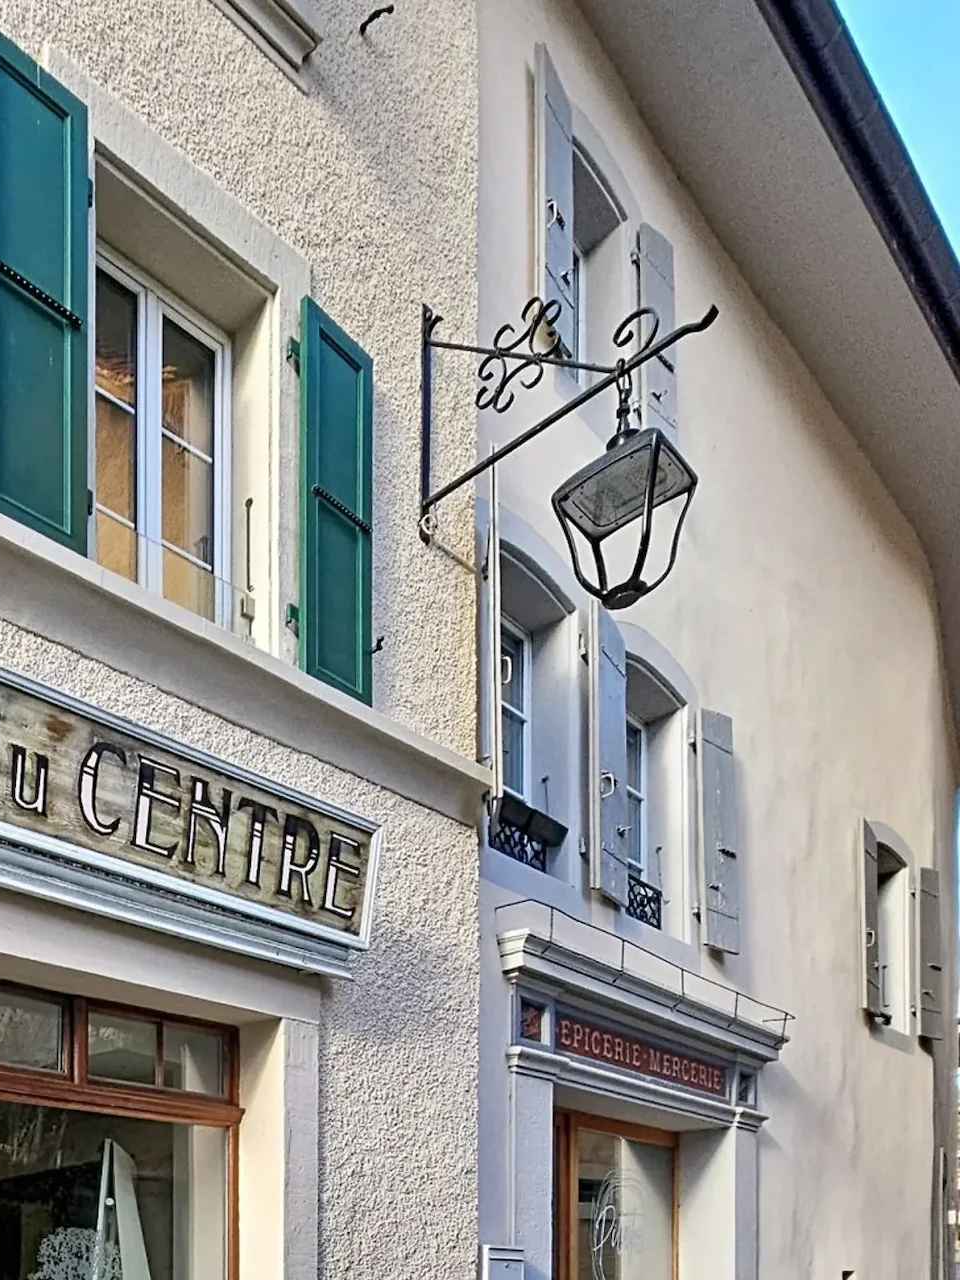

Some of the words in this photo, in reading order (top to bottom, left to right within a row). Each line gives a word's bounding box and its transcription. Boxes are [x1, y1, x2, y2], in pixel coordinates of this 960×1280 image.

[78, 742, 360, 919] CENTRE
[560, 1020, 641, 1066] EPICERIE
[649, 1052, 722, 1090] MERCERIE
